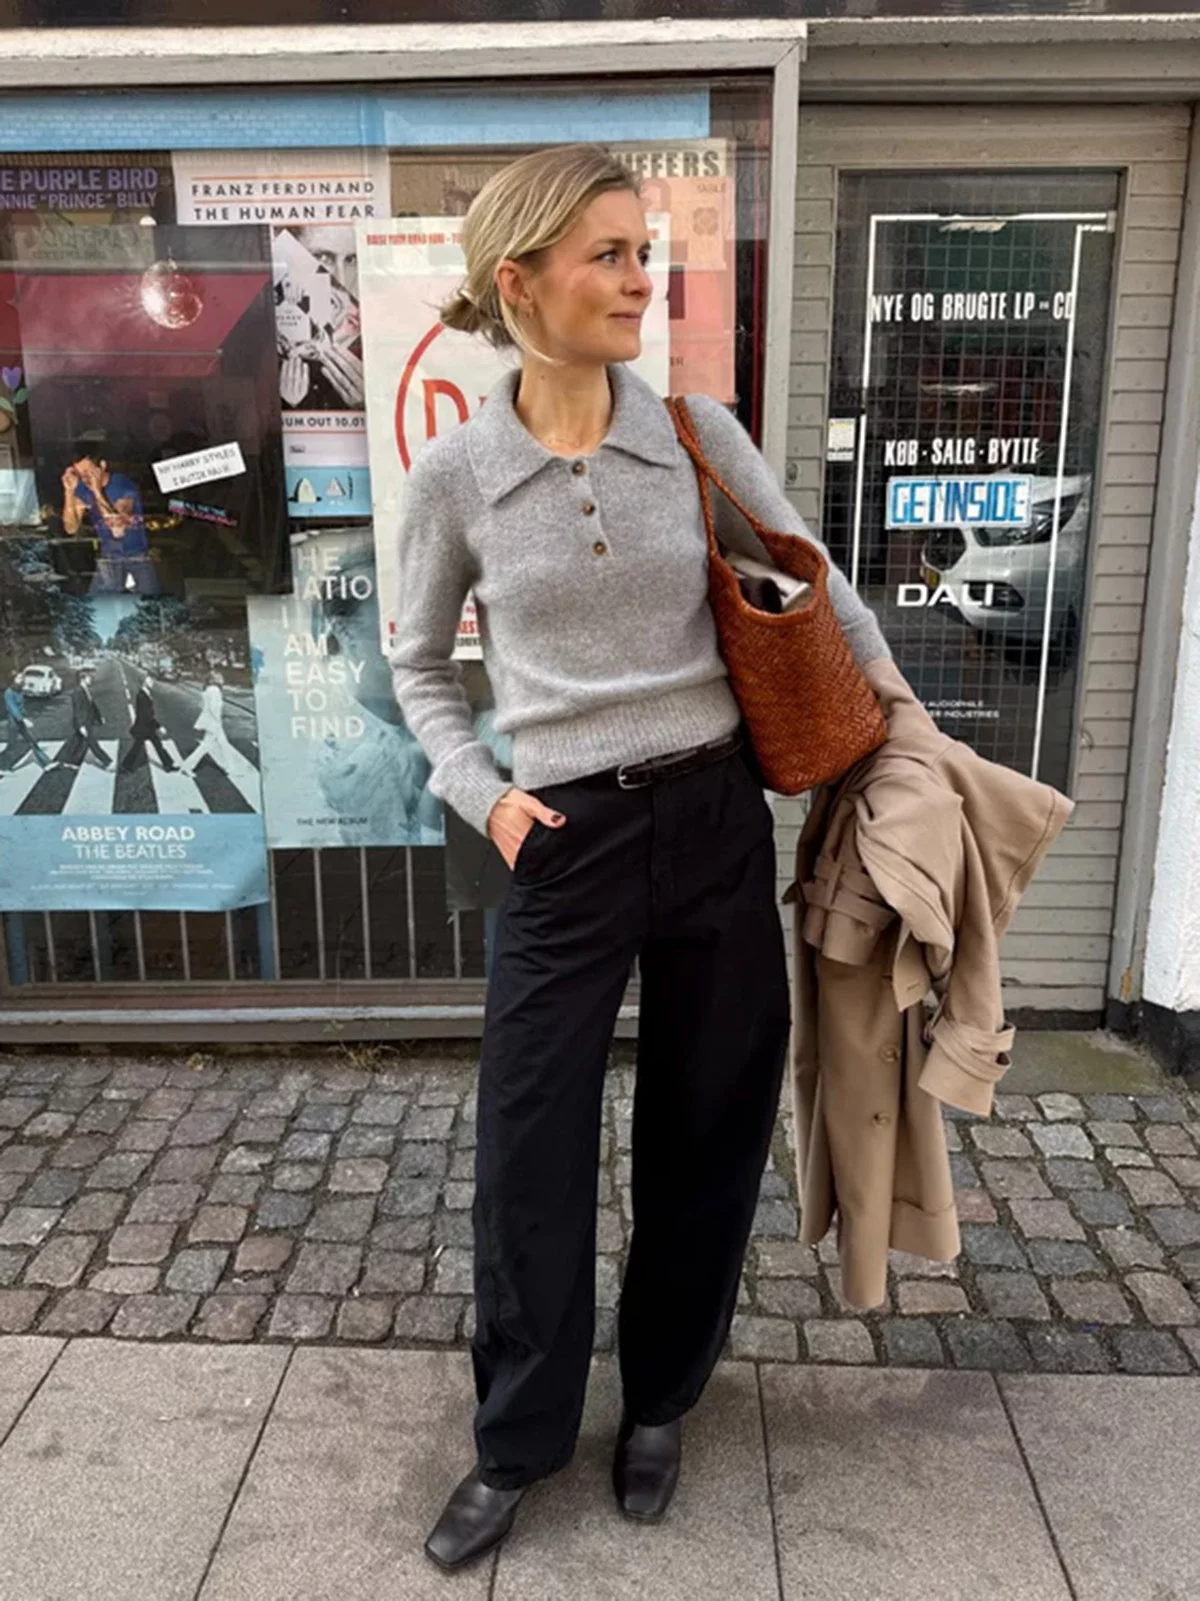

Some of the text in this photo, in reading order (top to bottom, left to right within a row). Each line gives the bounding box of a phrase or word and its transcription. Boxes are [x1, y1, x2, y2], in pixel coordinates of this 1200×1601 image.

[20, 169, 101, 191] PURPLE
[107, 167, 158, 190] BIRD
[192, 181, 375, 196] FRANZ FERDINAND
[116, 191, 157, 208] BILLY
[194, 204, 375, 221] THE HUMAN FEAR
[868, 294, 904, 323] NYE
[911, 292, 934, 322] OG
[942, 291, 1007, 321] BRUGTE
[1014, 292, 1036, 319] LP
[283, 416, 366, 428] UM OUT 10.01
[931, 437, 976, 465] SALG
[988, 437, 1040, 465] BYTTE
[896, 584, 994, 607] DALI
[283, 632, 328, 657] AM
[285, 659, 367, 685] EASY
[285, 687, 328, 713] TO
[944, 710, 1000, 719] INDUSTRIES
[290, 714, 366, 740] FIND
[61, 825, 196, 842] ABBEY ROAD
[73, 844, 187, 860] THE BEATLES
